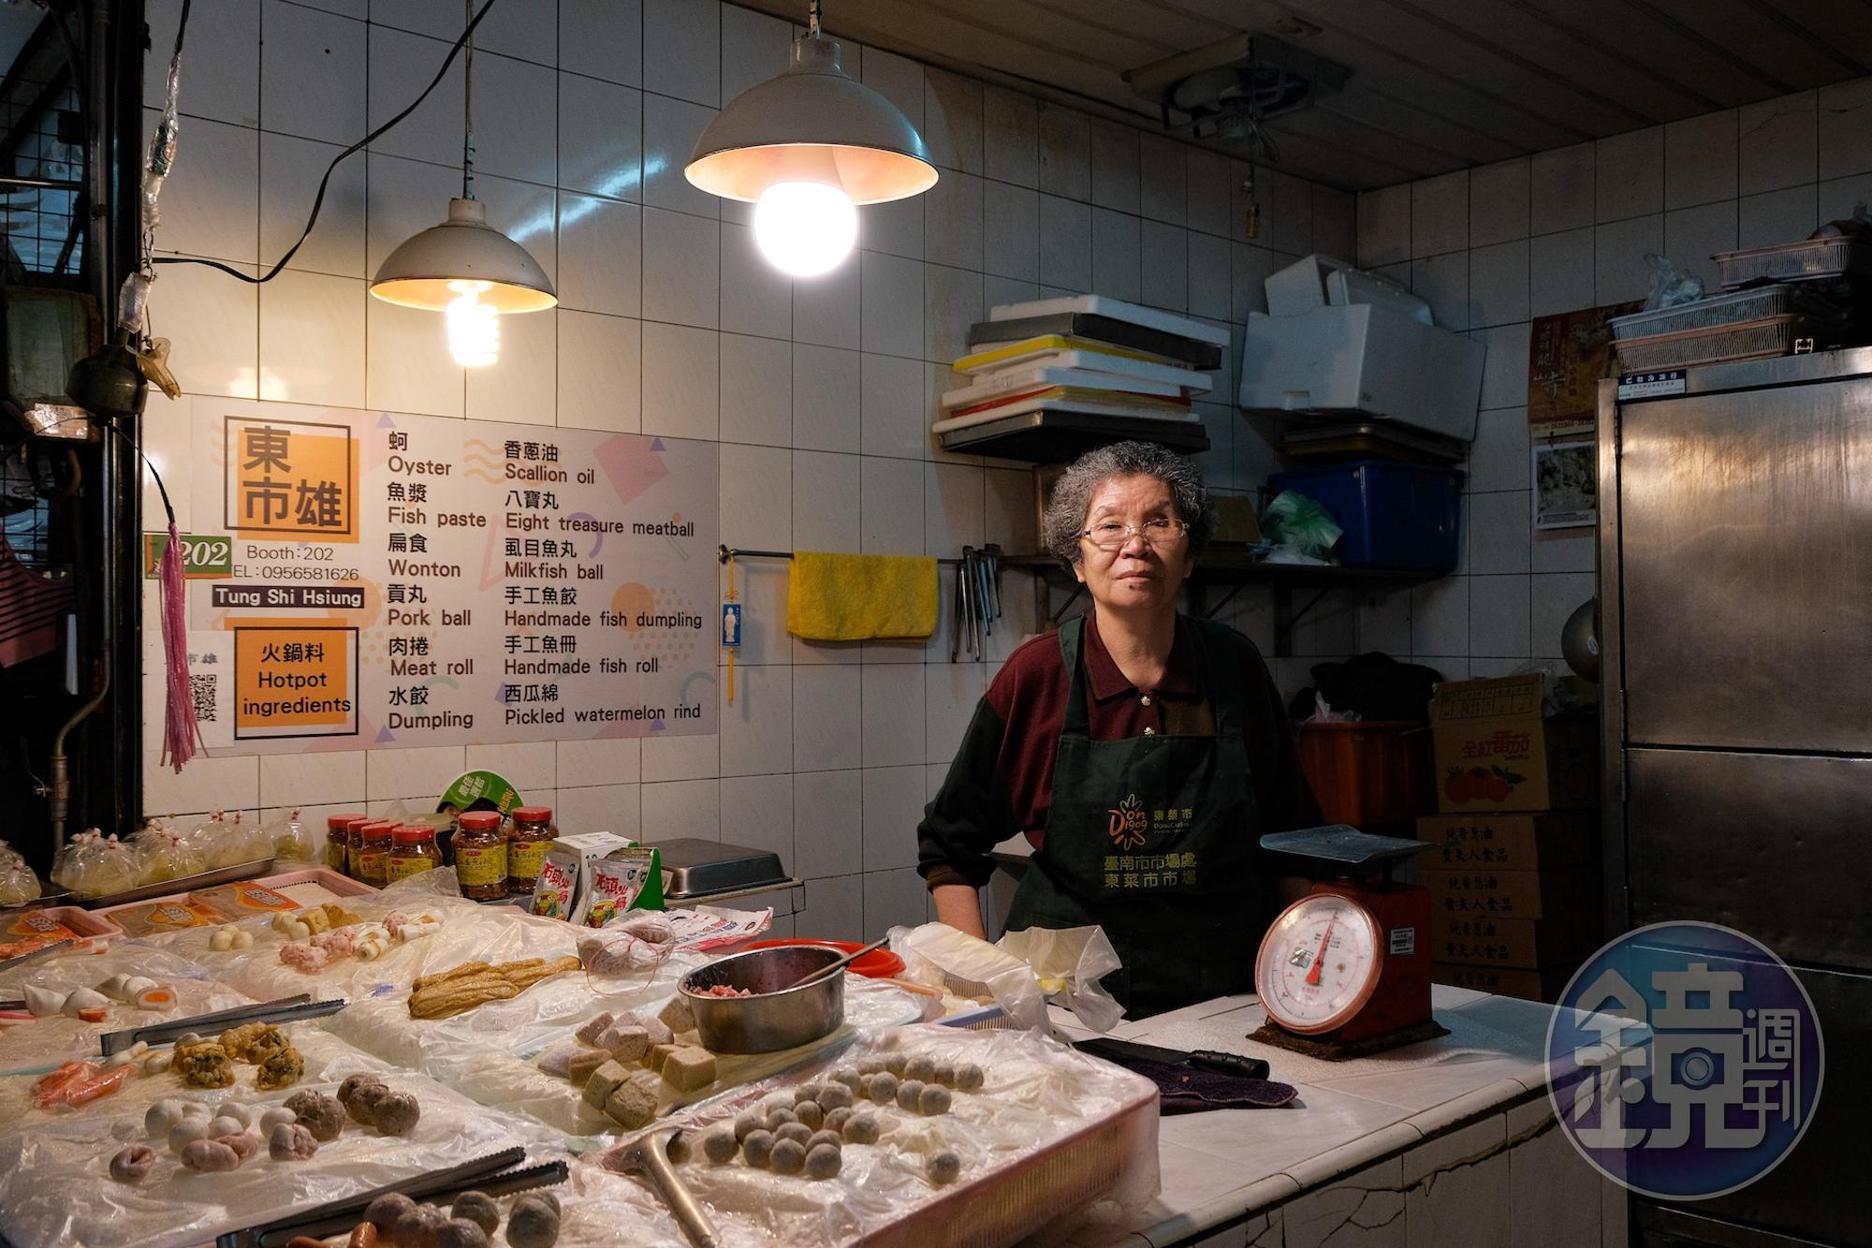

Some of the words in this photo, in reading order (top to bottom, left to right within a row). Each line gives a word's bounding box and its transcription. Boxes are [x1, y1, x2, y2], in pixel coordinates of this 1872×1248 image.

[243, 426, 292, 473] 東
[389, 431, 408, 451] 蚵
[504, 440, 559, 463] 香蔥油
[388, 456, 452, 476] Oyster
[506, 463, 567, 482] Scallion
[577, 468, 594, 484] oil
[242, 476, 343, 528] 市雄
[505, 490, 559, 510] 八寶丸
[389, 507, 426, 524] Fish
[438, 513, 486, 528] paste
[507, 513, 549, 531] Eight
[559, 518, 624, 533] treasure
[633, 522, 694, 537] meatball
[388, 533, 427, 553] 扁食
[505, 538, 577, 558] 虱目魚丸
[180, 541, 229, 566] 202
[233, 564, 360, 582] EL:0956581626
[388, 559, 460, 577] Wonton
[506, 561, 567, 579] Milkfish
[577, 564, 603, 580] ball
[215, 588, 261, 605] Tung
[267, 588, 295, 605] Shi
[302, 589, 362, 607] Hsiung
[387, 584, 427, 603] 貢丸
[505, 586, 577, 605] 手工魚餃
[388, 609, 430, 625] Pork
[442, 609, 470, 626] ball
[505, 610, 591, 626] Handmade
[600, 612, 627, 626] fish
[636, 612, 702, 629] dumpling
[261, 643, 324, 663] 火鍋料
[389, 637, 428, 656] 肉捲
[504, 635, 576, 654] 手工魚冊
[391, 659, 436, 676] Meat
[448, 659, 473, 675] roll
[505, 658, 590, 674] Handmade
[600, 659, 627, 673] fish
[636, 657, 658, 673] roll
[259, 672, 327, 690] Hotpot
[389, 686, 429, 706] 水餃
[504, 684, 558, 703] 西瓜綿
[244, 696, 350, 717] ingredients
[506, 708, 564, 724] Pickled
[575, 707, 665, 723] watermelon
[674, 704, 700, 718] rind
[389, 712, 473, 730] Dumpling
